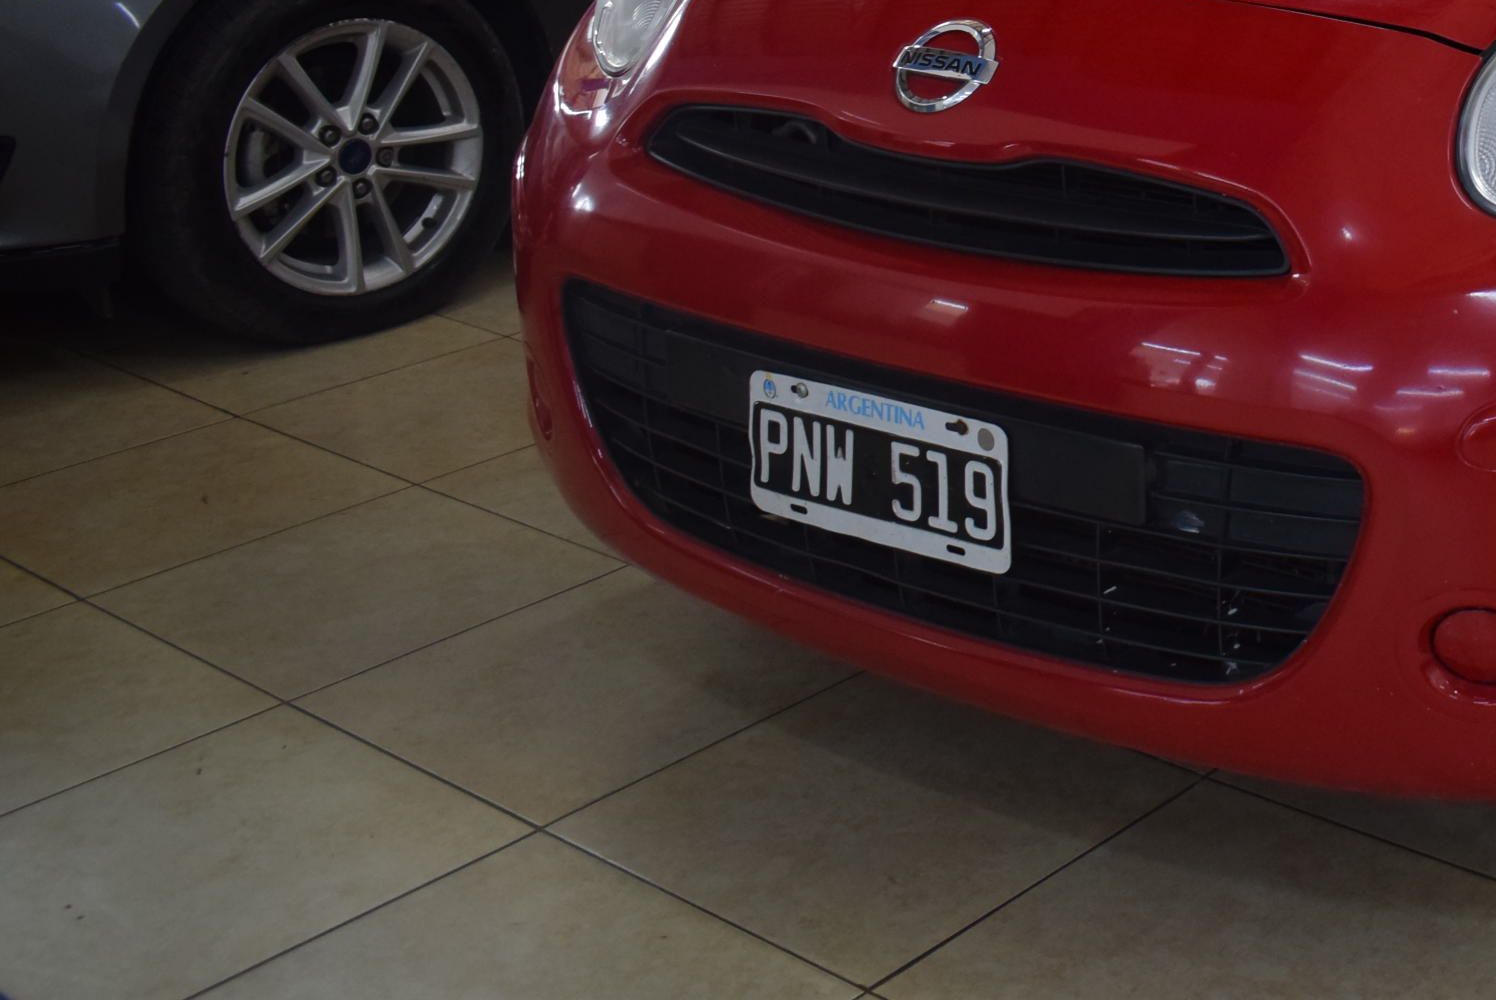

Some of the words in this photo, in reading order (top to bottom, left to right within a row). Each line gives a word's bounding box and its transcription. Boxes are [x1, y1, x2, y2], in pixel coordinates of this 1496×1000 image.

[901, 49, 982, 76] NISSAN
[825, 390, 925, 431] ARGENTINA
[759, 407, 854, 506] PNW
[891, 440, 997, 542] 519
